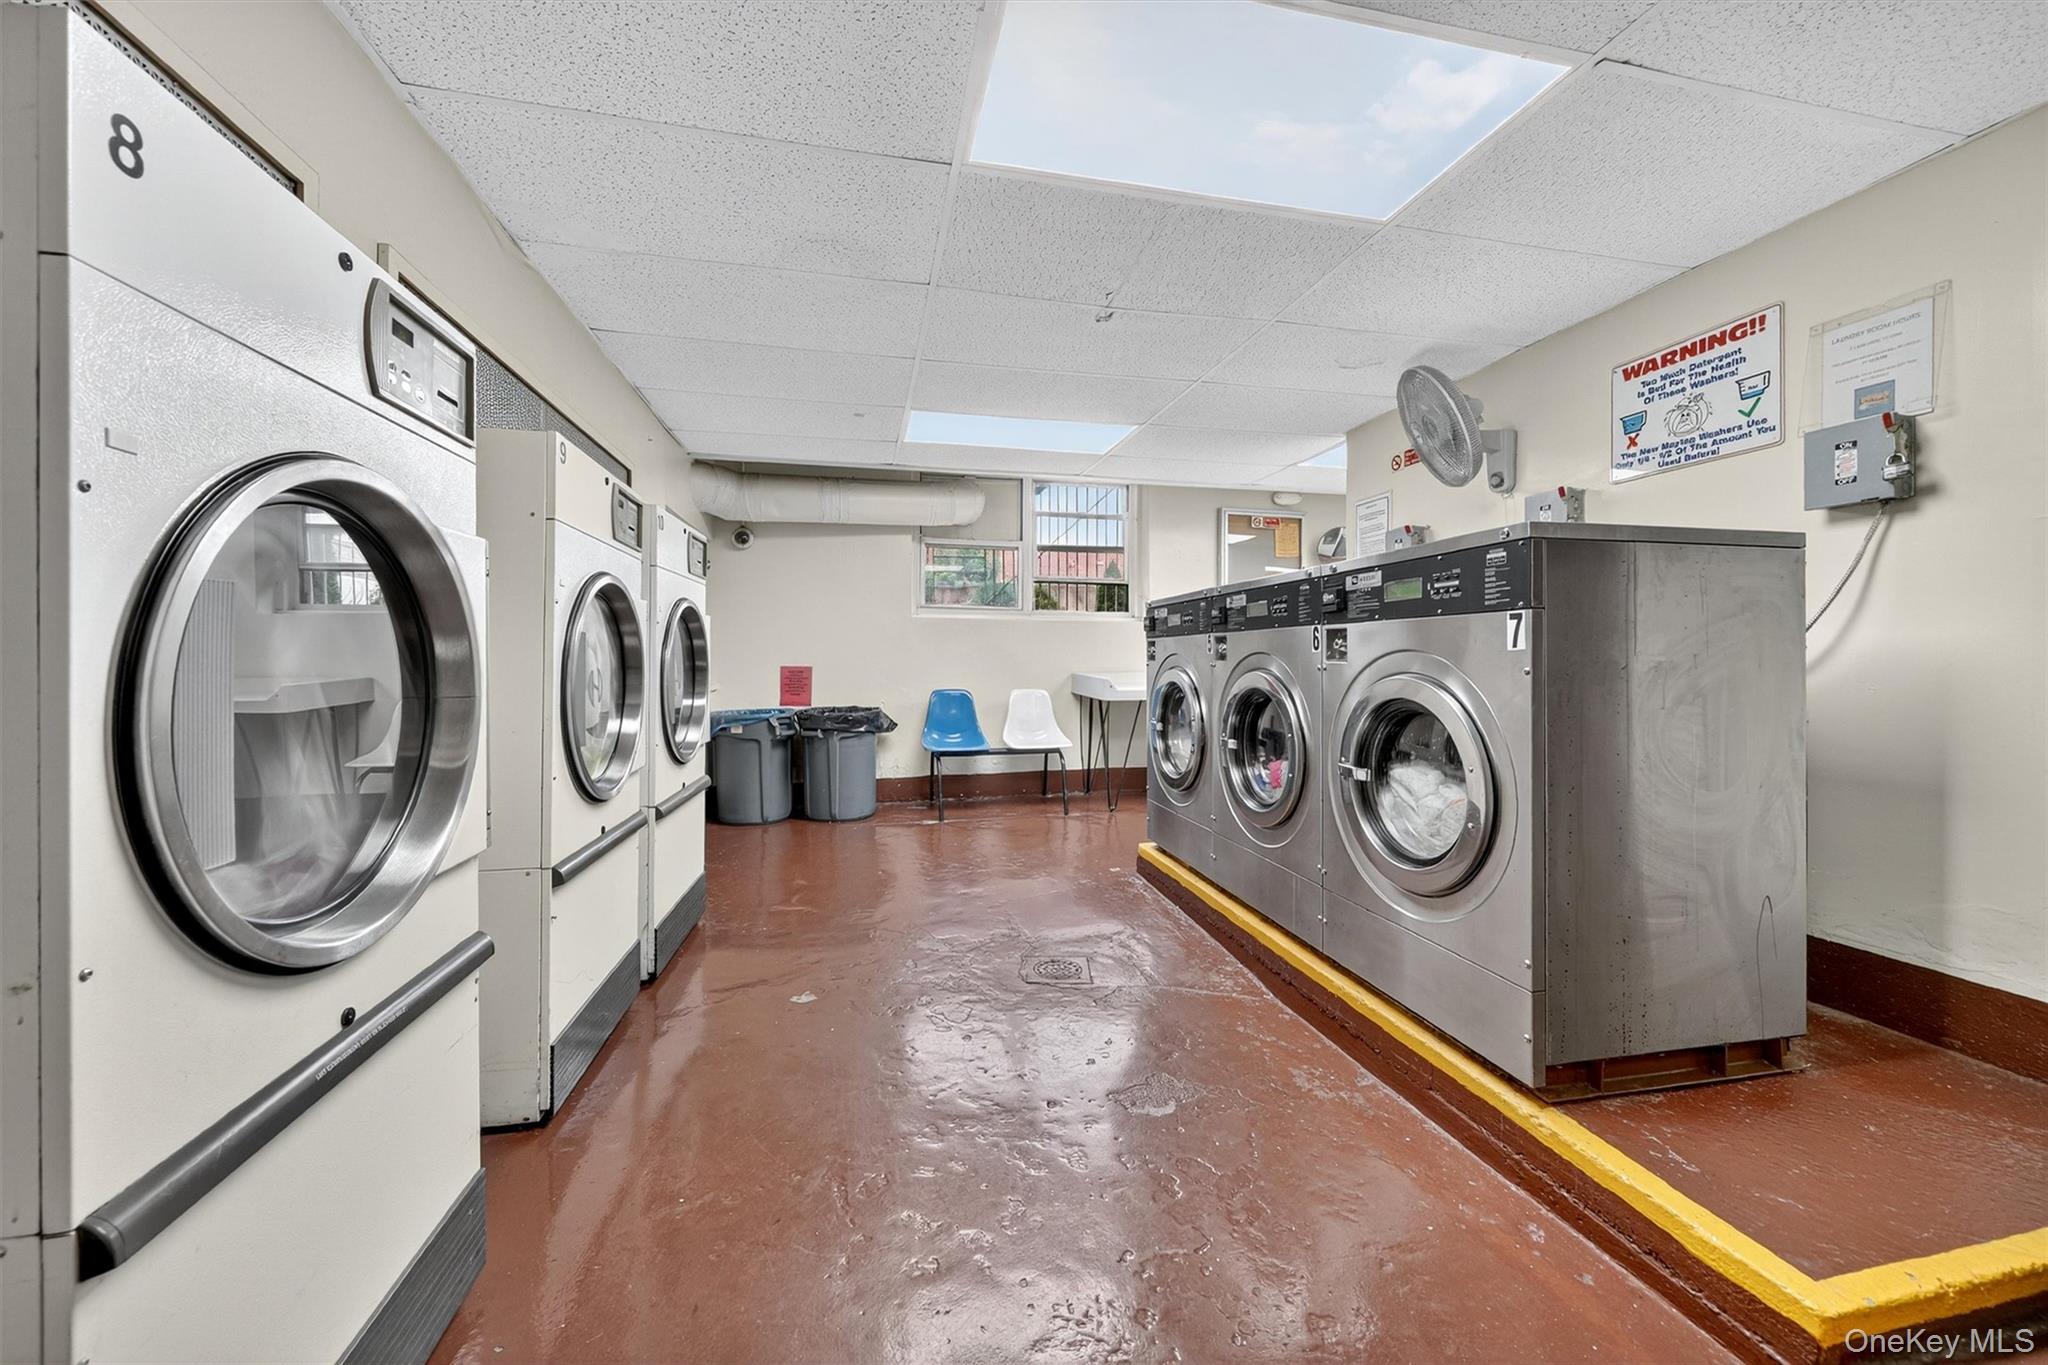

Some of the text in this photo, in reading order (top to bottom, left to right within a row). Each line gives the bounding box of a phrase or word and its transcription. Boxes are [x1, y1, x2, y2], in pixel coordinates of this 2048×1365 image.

[108, 113, 144, 179] 8
[1622, 314, 1767, 382] WARNING!!
[1641, 348, 1742, 389] Too Much Detergent
[1669, 378, 1685, 388] For
[1688, 370, 1707, 381] The
[1711, 356, 1747, 373] Health
[1643, 394, 1655, 405] Of
[1658, 388, 1686, 400] These
[1690, 368, 1739, 390] Washers!
[1676, 445, 1687, 456] Of
[1690, 442, 1708, 452] The
[1711, 430, 1753, 447] Amount
[1757, 425, 1777, 436] You
[1699, 424, 1743, 440] Washers
[560, 441, 566, 464] 9
[1312, 626, 1320, 651] 6
[1509, 612, 1523, 648] 7
